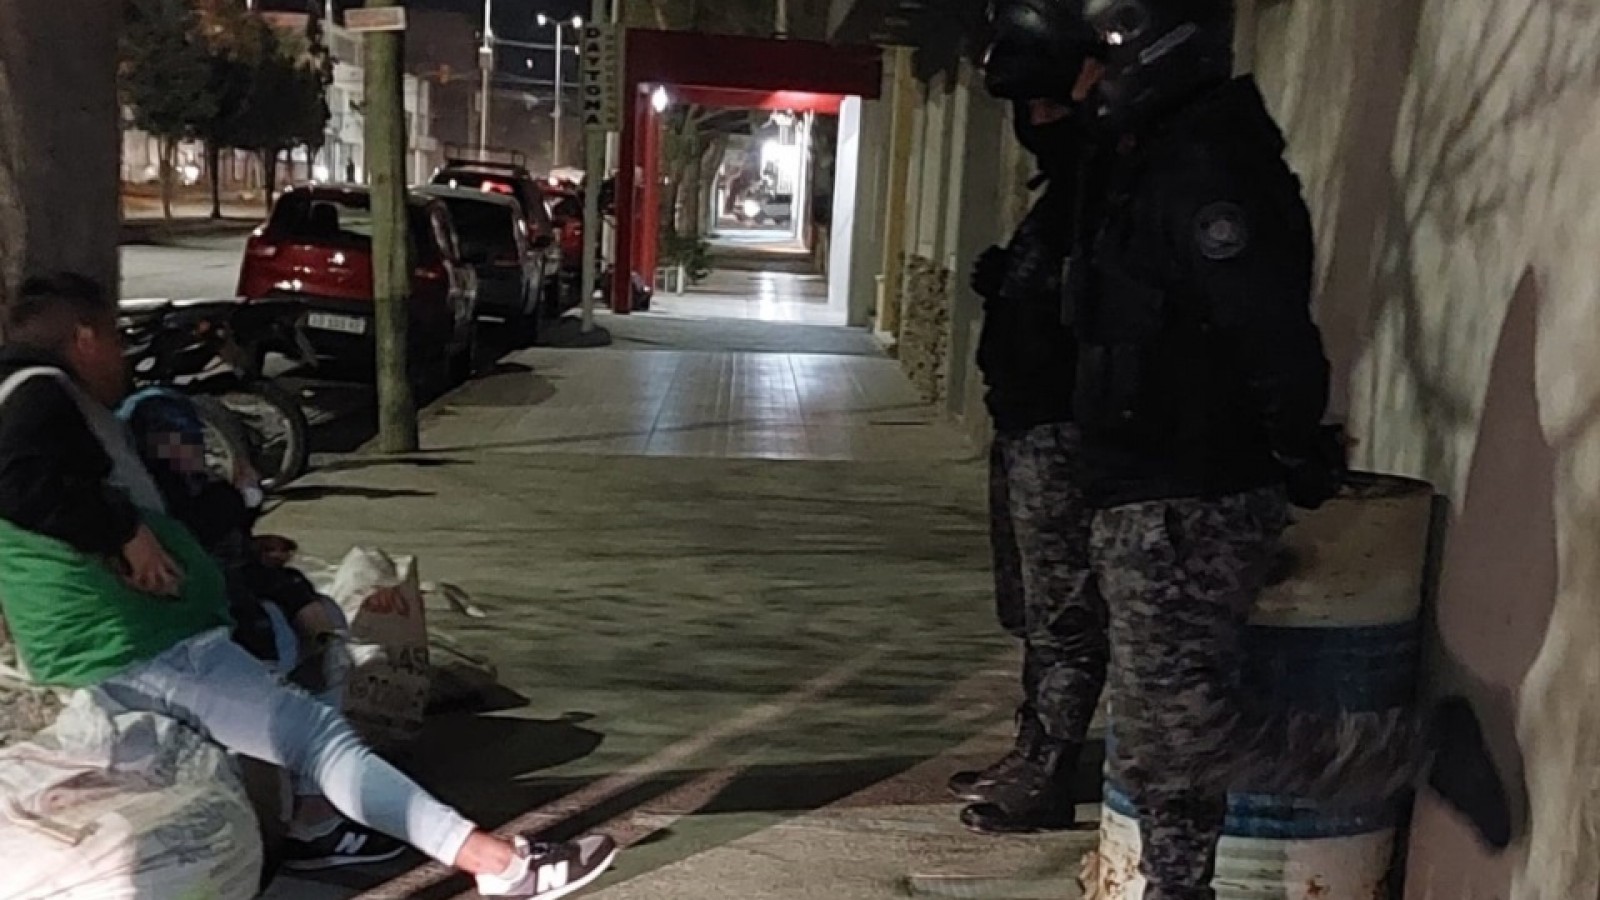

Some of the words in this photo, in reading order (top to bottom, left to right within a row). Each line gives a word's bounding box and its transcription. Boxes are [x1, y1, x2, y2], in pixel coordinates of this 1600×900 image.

[584, 27, 601, 124] DAYTONA
[335, 831, 368, 855] N
[536, 860, 569, 891] N
